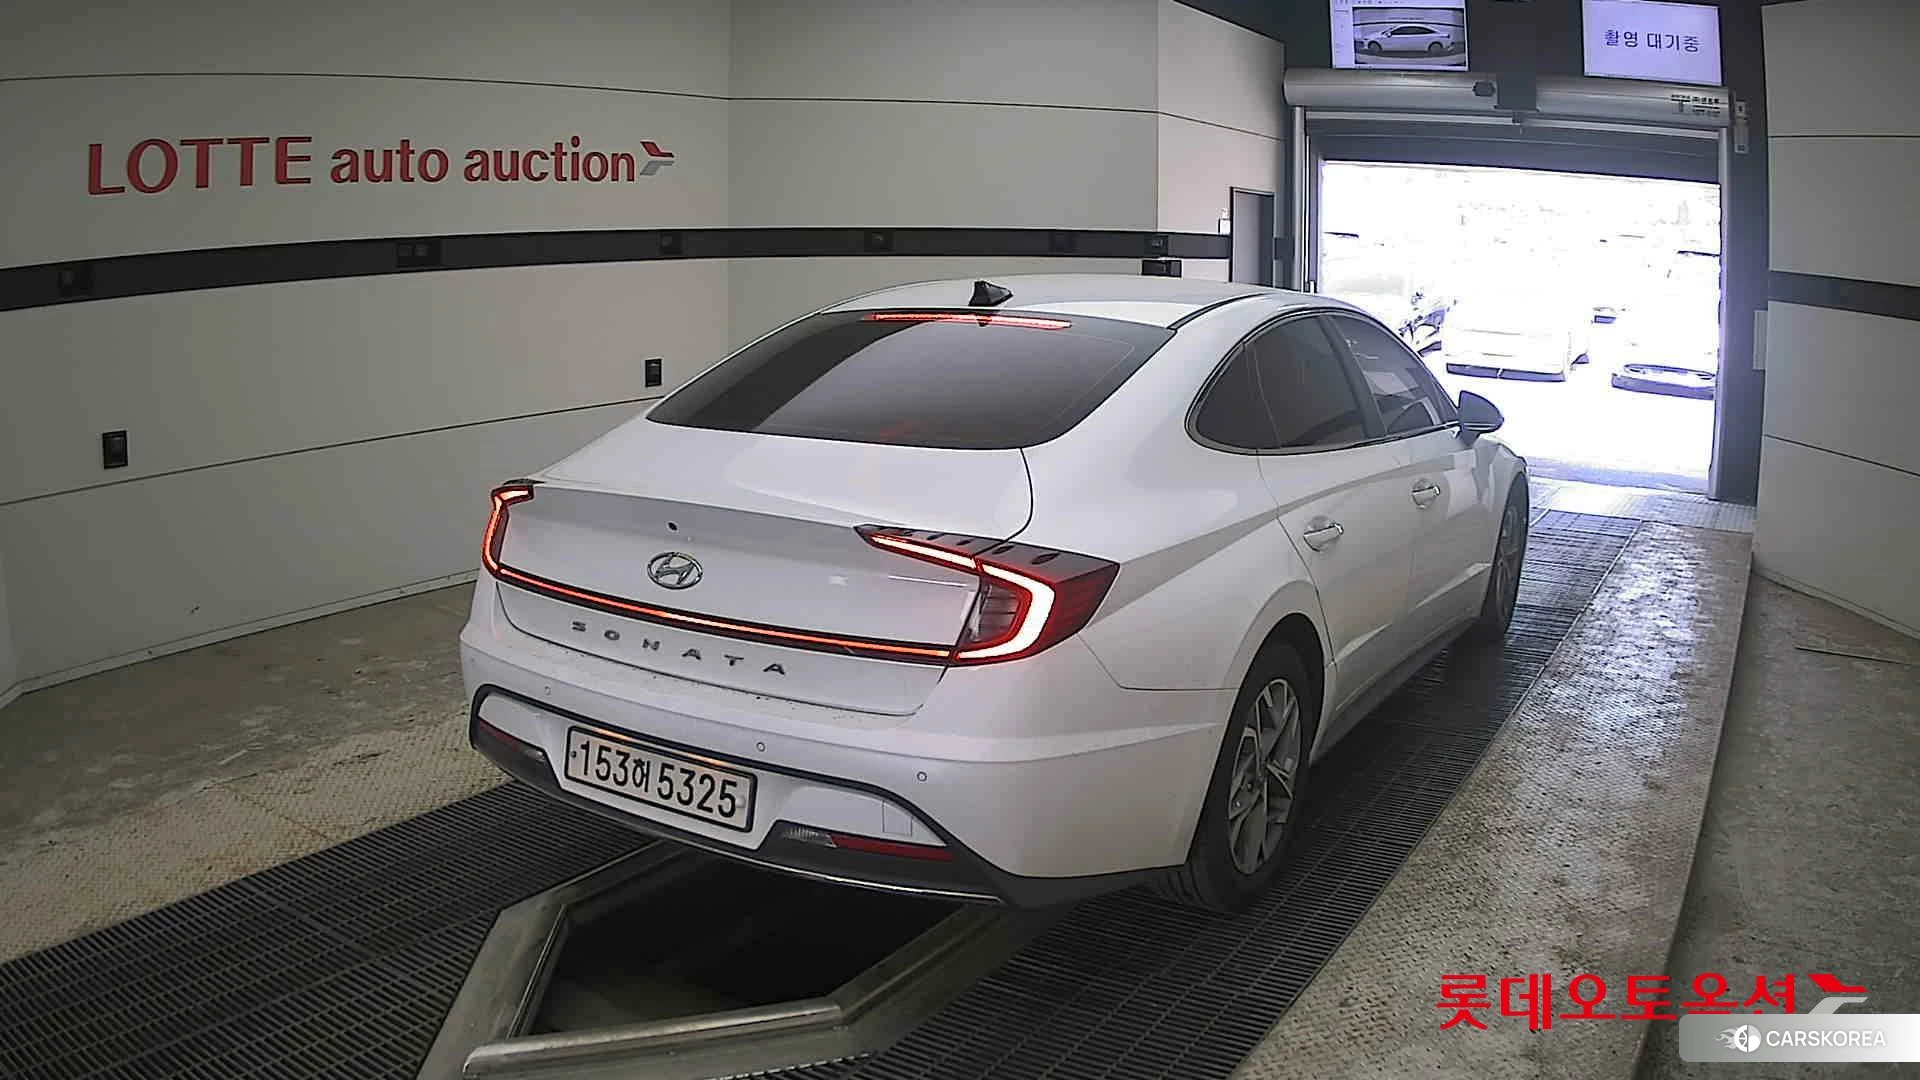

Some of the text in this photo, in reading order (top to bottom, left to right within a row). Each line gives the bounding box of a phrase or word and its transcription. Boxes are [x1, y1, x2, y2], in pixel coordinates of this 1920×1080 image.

[1605, 29, 1700, 52] 촬영 대기중
[88, 136, 636, 195] LOTTE auto auction
[572, 621, 785, 675] SONATA
